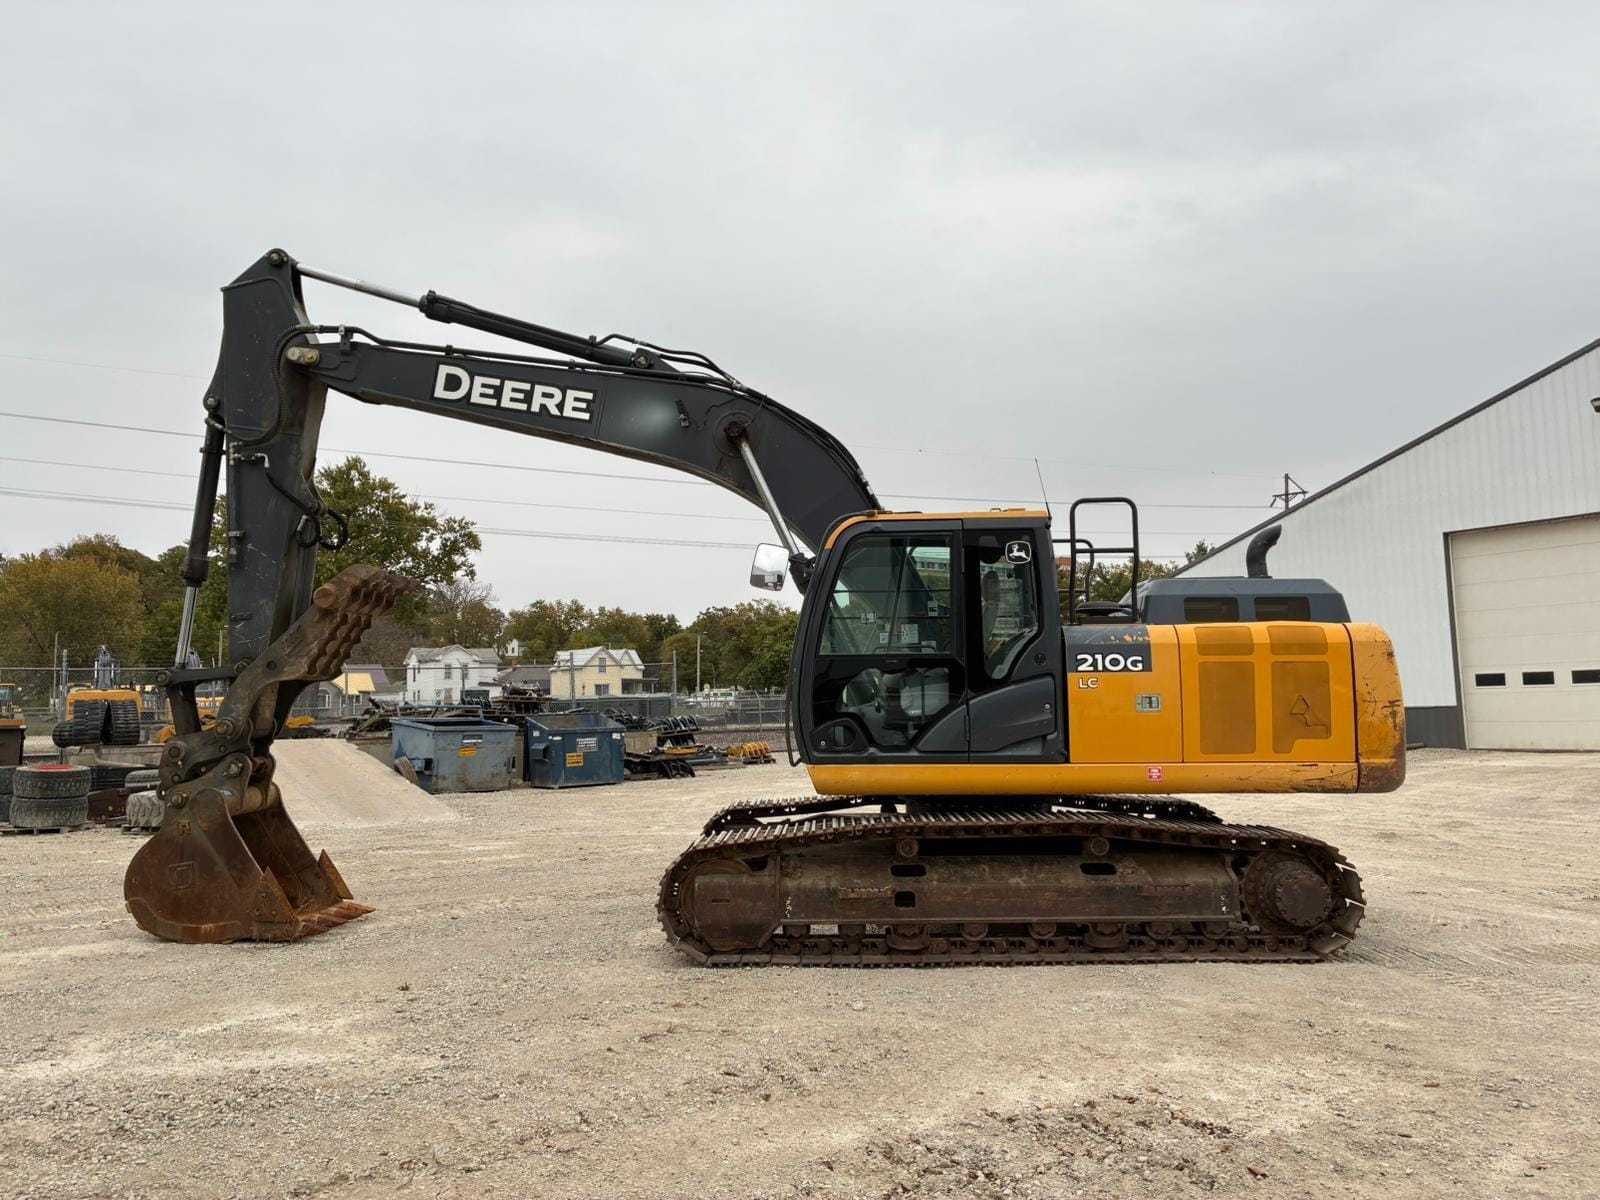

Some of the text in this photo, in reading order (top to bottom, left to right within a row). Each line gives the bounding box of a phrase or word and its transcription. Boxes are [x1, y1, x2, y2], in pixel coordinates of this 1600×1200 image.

[433, 364, 594, 421] DEERE
[1076, 654, 1144, 672] 210G
[1079, 678, 1099, 689] LC
